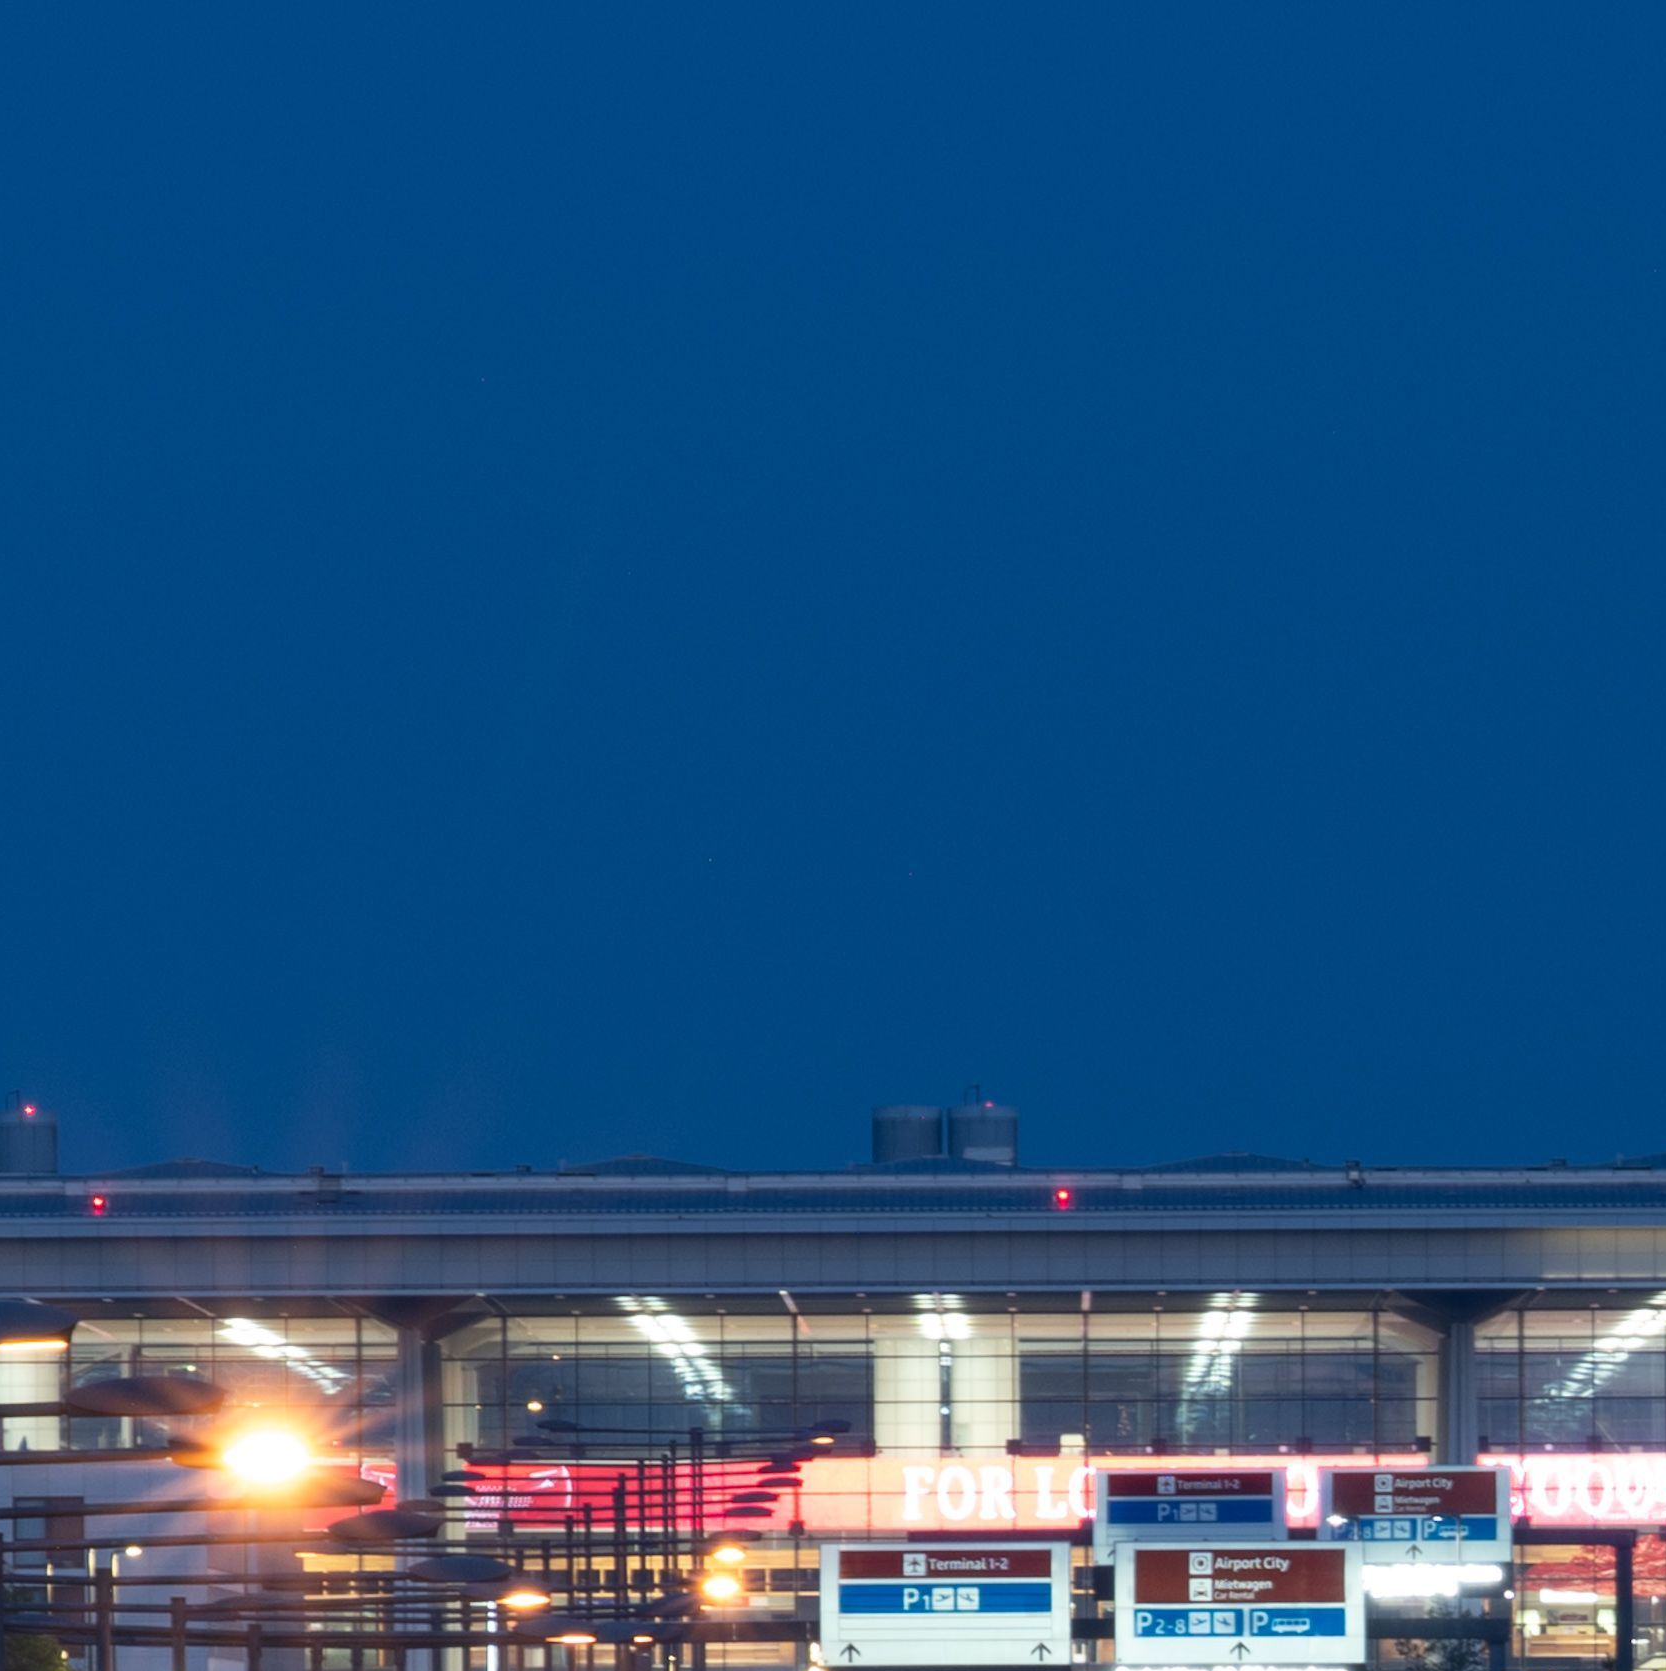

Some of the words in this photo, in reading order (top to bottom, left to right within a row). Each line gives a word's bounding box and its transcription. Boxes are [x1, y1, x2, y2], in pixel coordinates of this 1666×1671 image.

[1177, 1480, 1222, 1490] Terminal
[1223, 1480, 1241, 1490] 1-2
[1395, 1478, 1432, 1490] Airport
[1433, 1478, 1453, 1490] City
[902, 1465, 1017, 1521] FOR
[928, 1557, 987, 1571] Terminal
[988, 1557, 1010, 1571] 1-2
[1214, 1556, 1262, 1572] Airport
[1263, 1556, 1290, 1572] City
[1214, 1579, 1274, 1592] Mietwagen
[1214, 1591, 1228, 1600] Car
[1252, 1611, 1269, 1634] P
